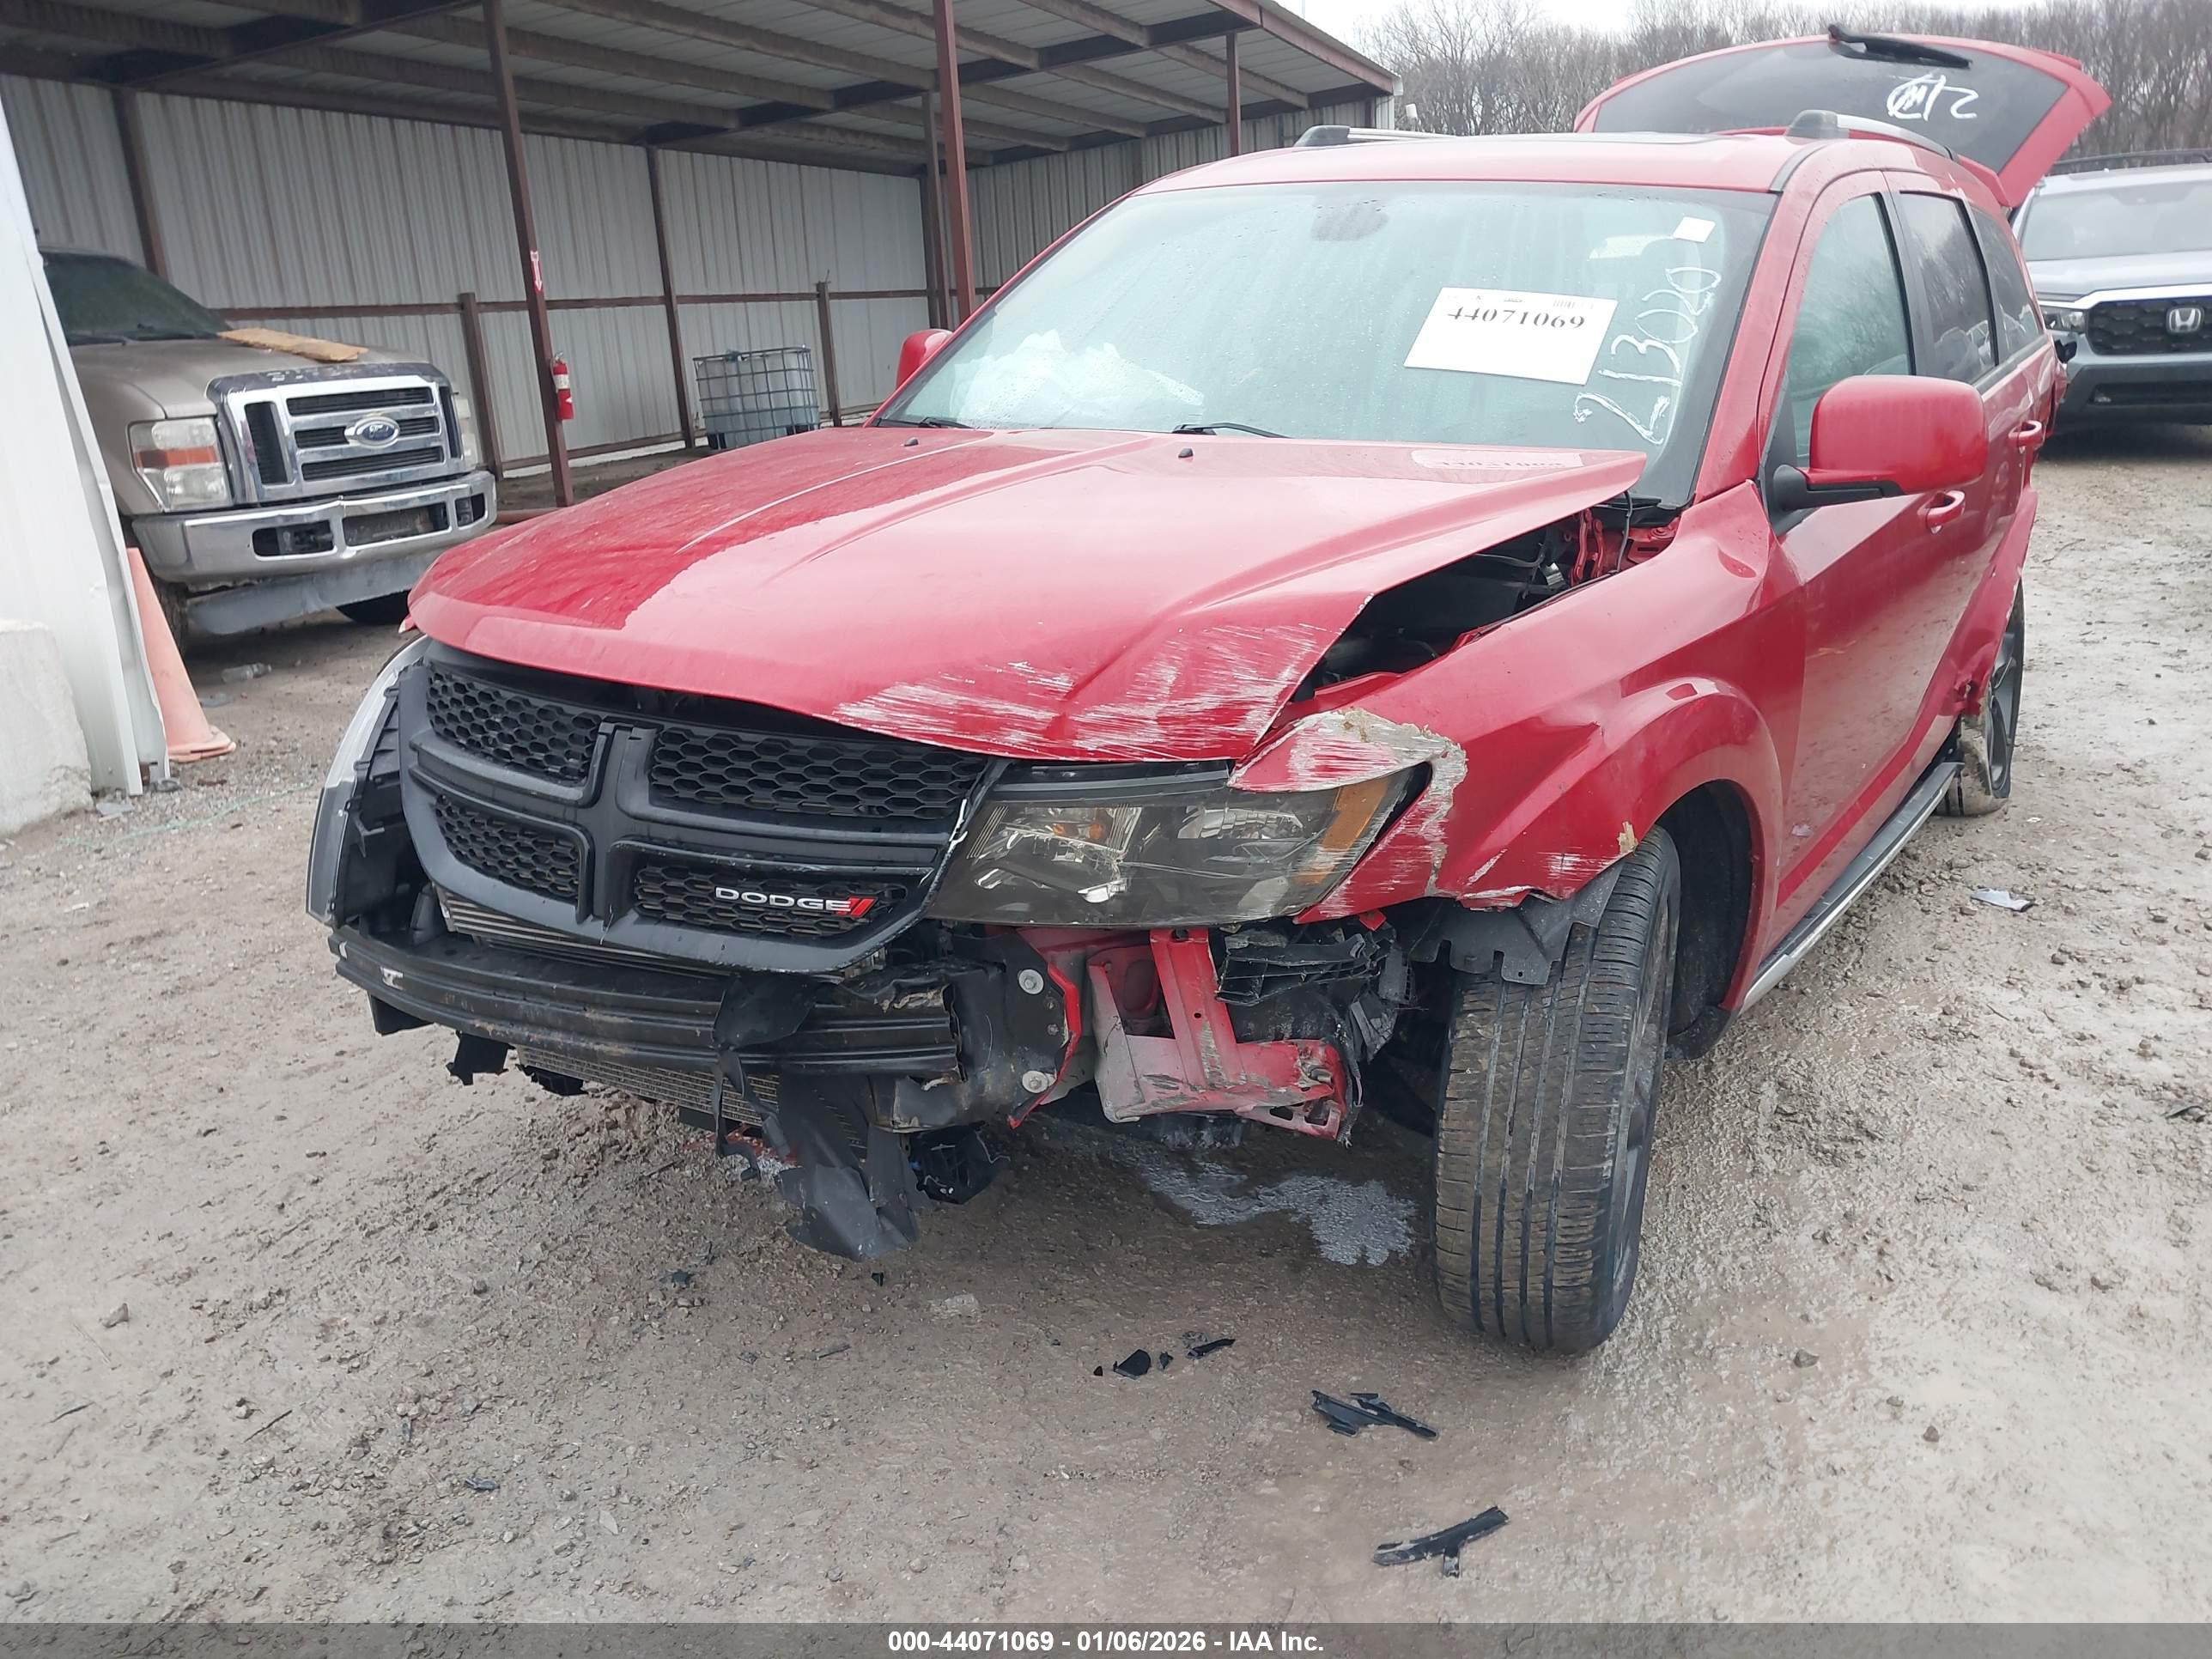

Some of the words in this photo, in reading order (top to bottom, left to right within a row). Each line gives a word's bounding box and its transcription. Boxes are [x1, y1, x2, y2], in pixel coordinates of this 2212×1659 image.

[1448, 307, 1585, 329] 44071069
[1573, 266, 1721, 445] 213020
[715, 887, 851, 912] DODGE
